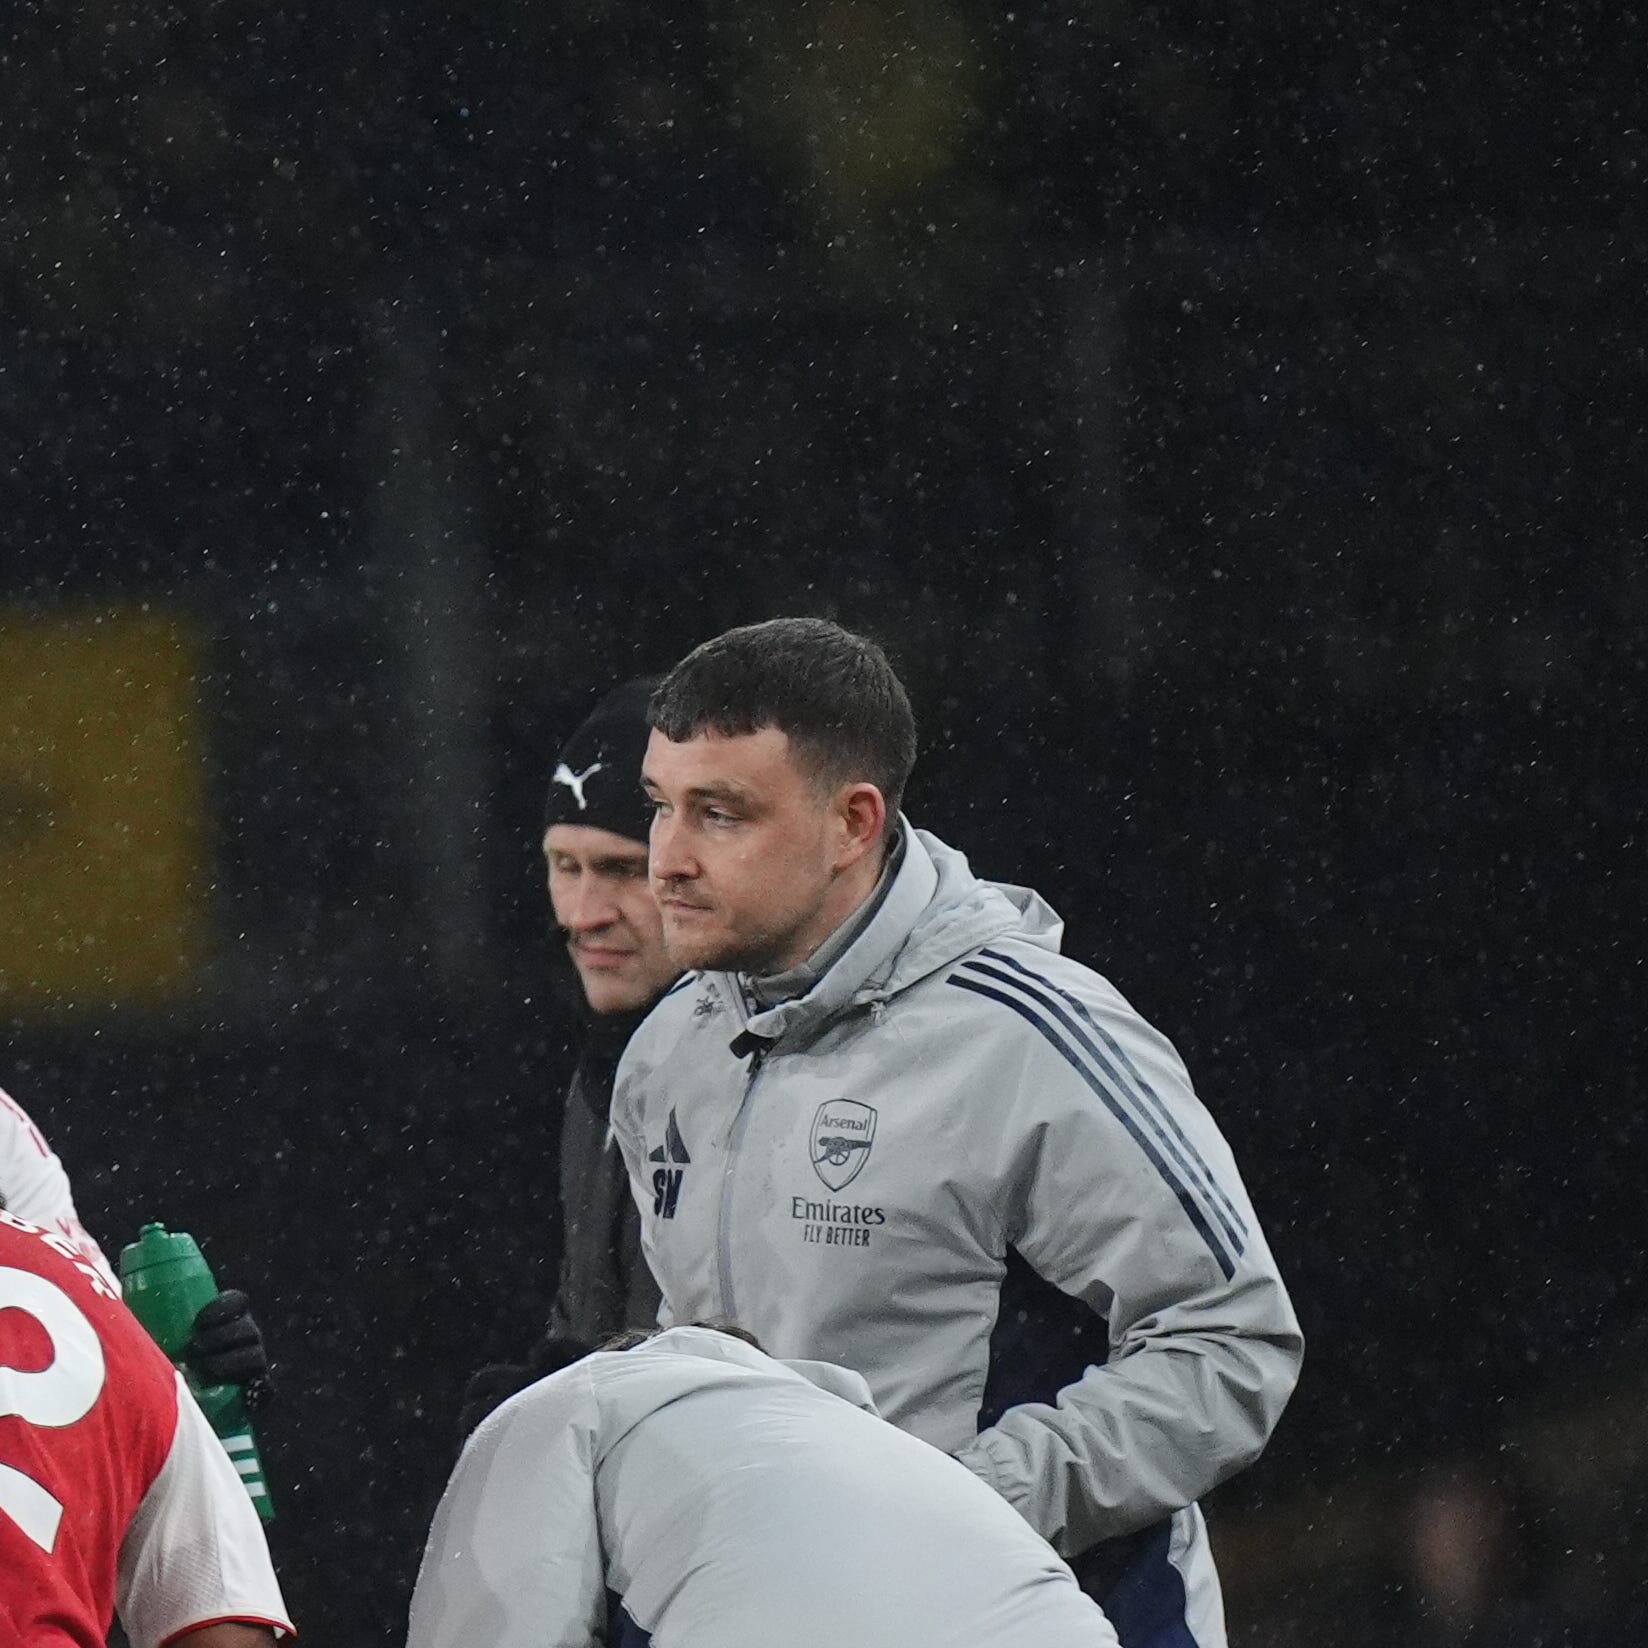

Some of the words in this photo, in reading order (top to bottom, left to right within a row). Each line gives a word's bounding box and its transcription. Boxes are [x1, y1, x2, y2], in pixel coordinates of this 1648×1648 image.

[820, 1113, 868, 1131] Arsenal
[792, 1196, 886, 1225] Emirates
[804, 1224, 823, 1243] FLY
[825, 1227, 871, 1247] BETTER
